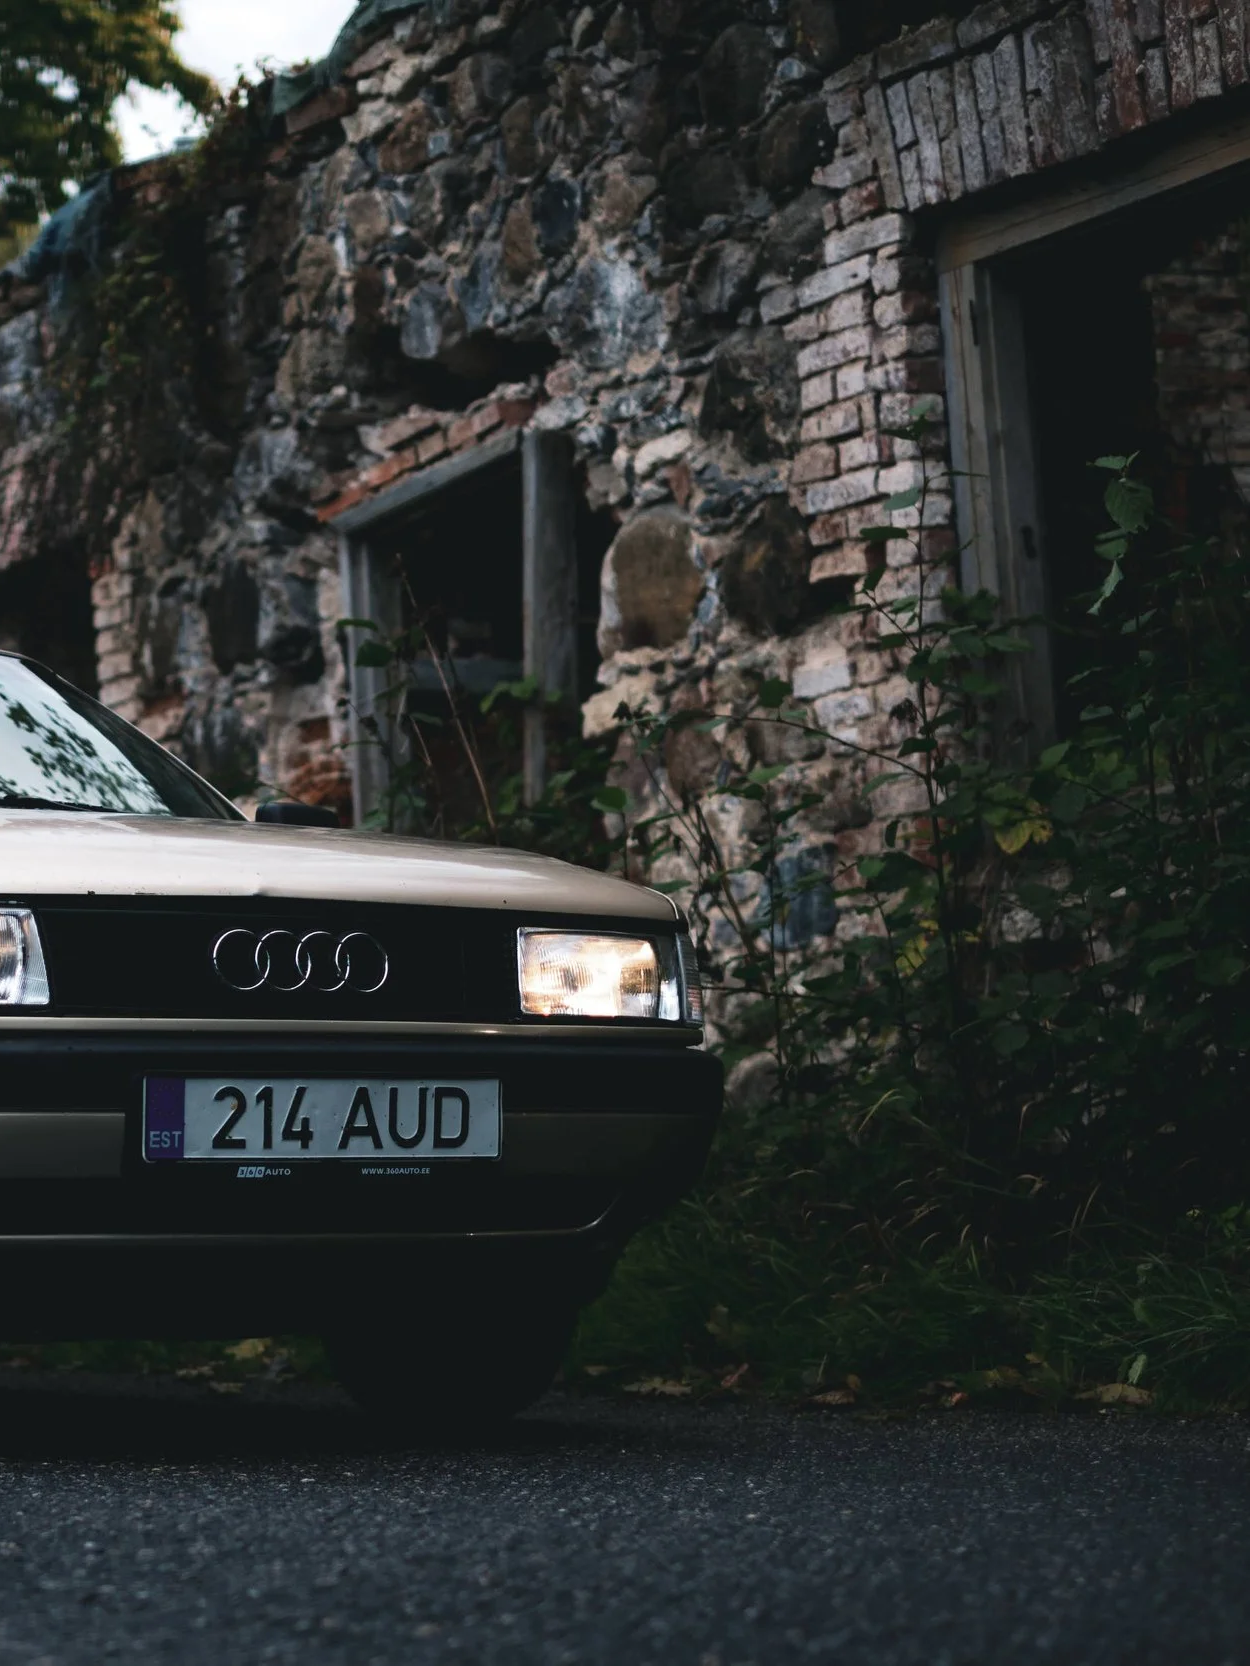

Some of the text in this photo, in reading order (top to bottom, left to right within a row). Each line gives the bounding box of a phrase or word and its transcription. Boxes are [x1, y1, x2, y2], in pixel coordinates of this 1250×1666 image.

[211, 1085, 470, 1150] 214 AUD
[149, 1130, 182, 1149] EST
[361, 1167, 431, 1176] WWW.360AUTO.EE
